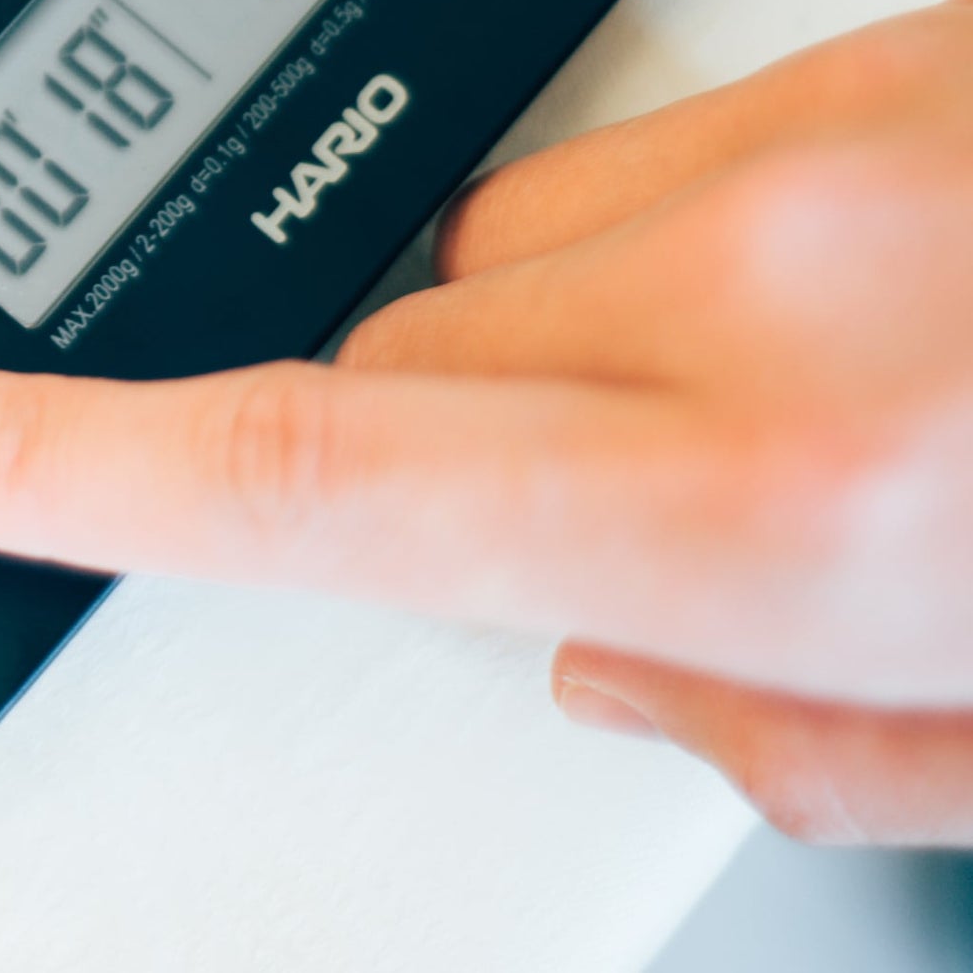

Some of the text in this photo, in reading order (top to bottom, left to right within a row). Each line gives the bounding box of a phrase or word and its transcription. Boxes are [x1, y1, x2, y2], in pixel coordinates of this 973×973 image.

[50, 259, 140, 349] MAX.2000g
[135, 194, 196, 253] 2-200g
[190, 137, 246, 193] d=0.1g
[243, 57, 315, 129] 200-500g
[310, 1, 363, 55] d=0.5g
[251, 75, 409, 244] HARIO
